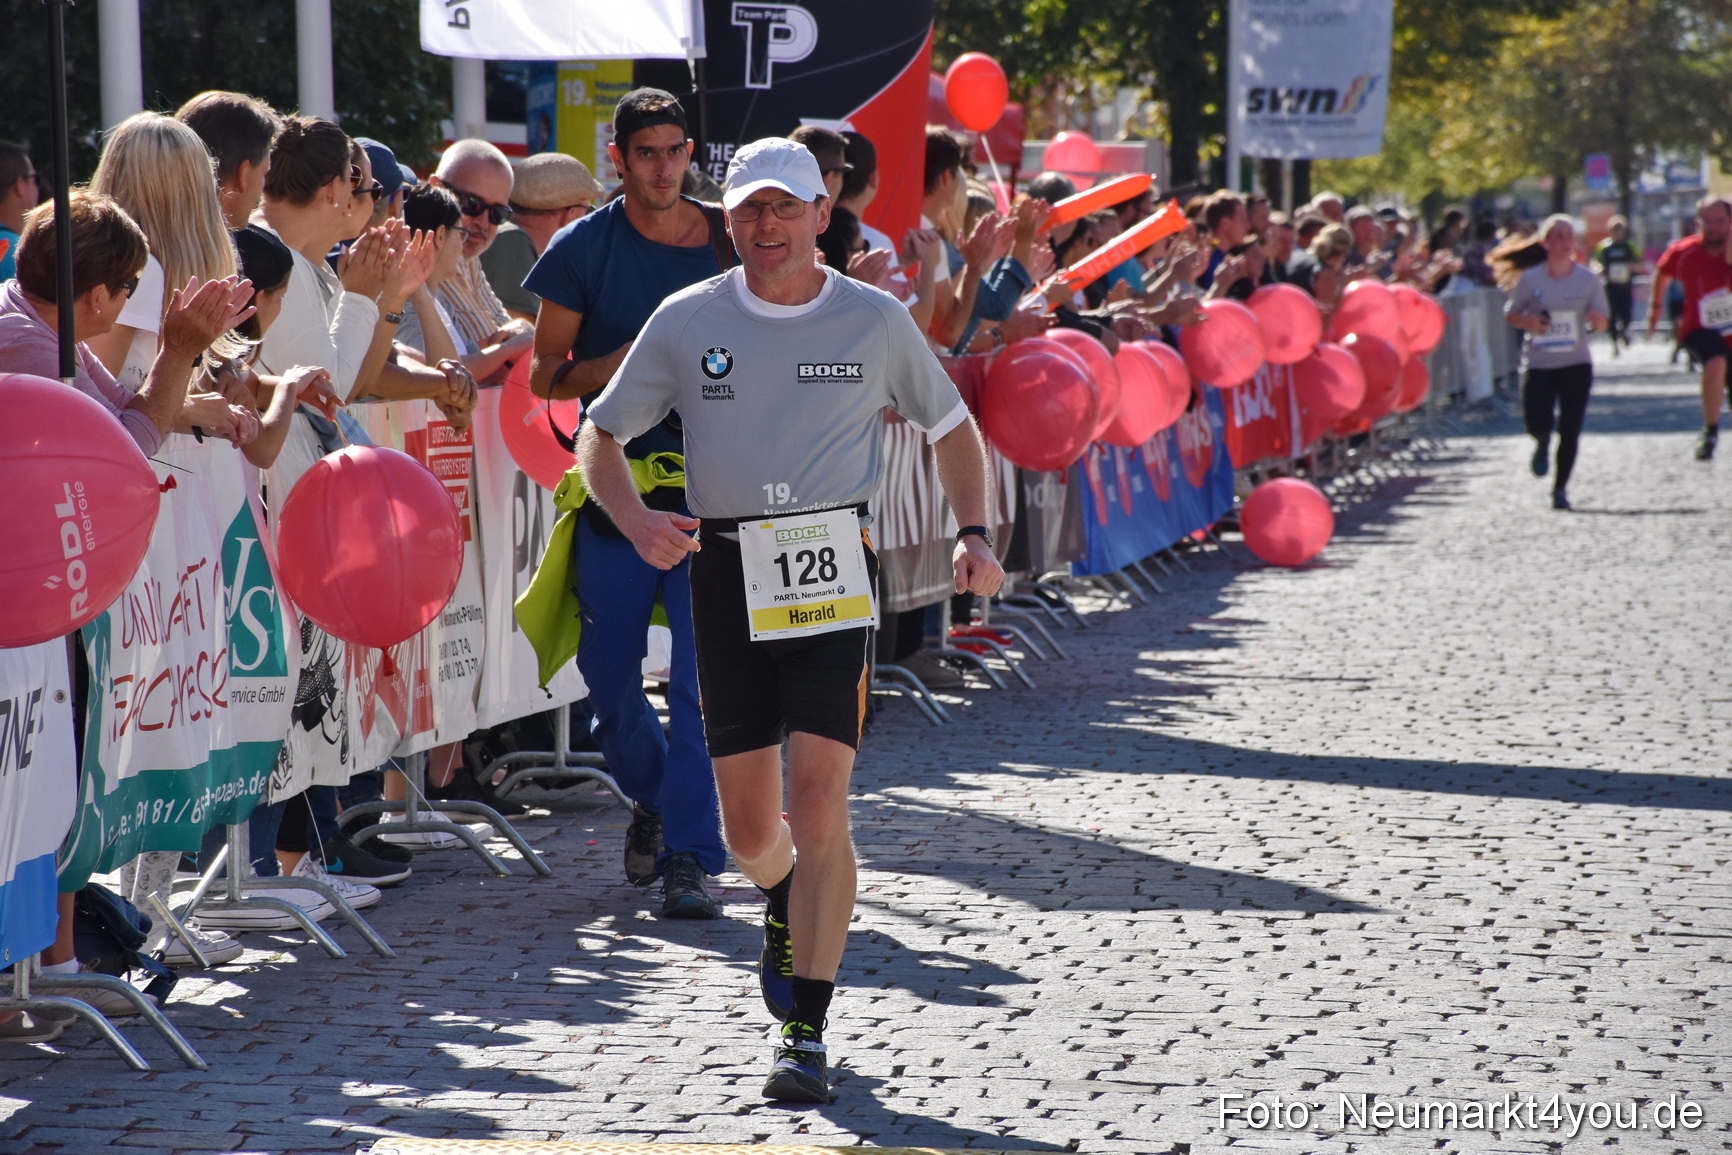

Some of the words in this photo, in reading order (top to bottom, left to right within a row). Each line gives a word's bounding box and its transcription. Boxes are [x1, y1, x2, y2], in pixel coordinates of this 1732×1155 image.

[738, 10, 762, 19] Team
[562, 79, 593, 106] 19.
[1246, 87, 1338, 115] swn
[798, 363, 863, 378] BOCK
[702, 384, 735, 394] PARTL
[702, 393, 735, 401] Neumarkt
[762, 482, 798, 505] 19.
[74, 481, 96, 551] energie
[775, 524, 830, 543] BOCK
[773, 547, 838, 587] 128
[774, 594, 800, 602] PARTL
[802, 588, 835, 599] Neumarkt
[789, 604, 836, 625] Harald
[258, 686, 286, 704] GmbH
